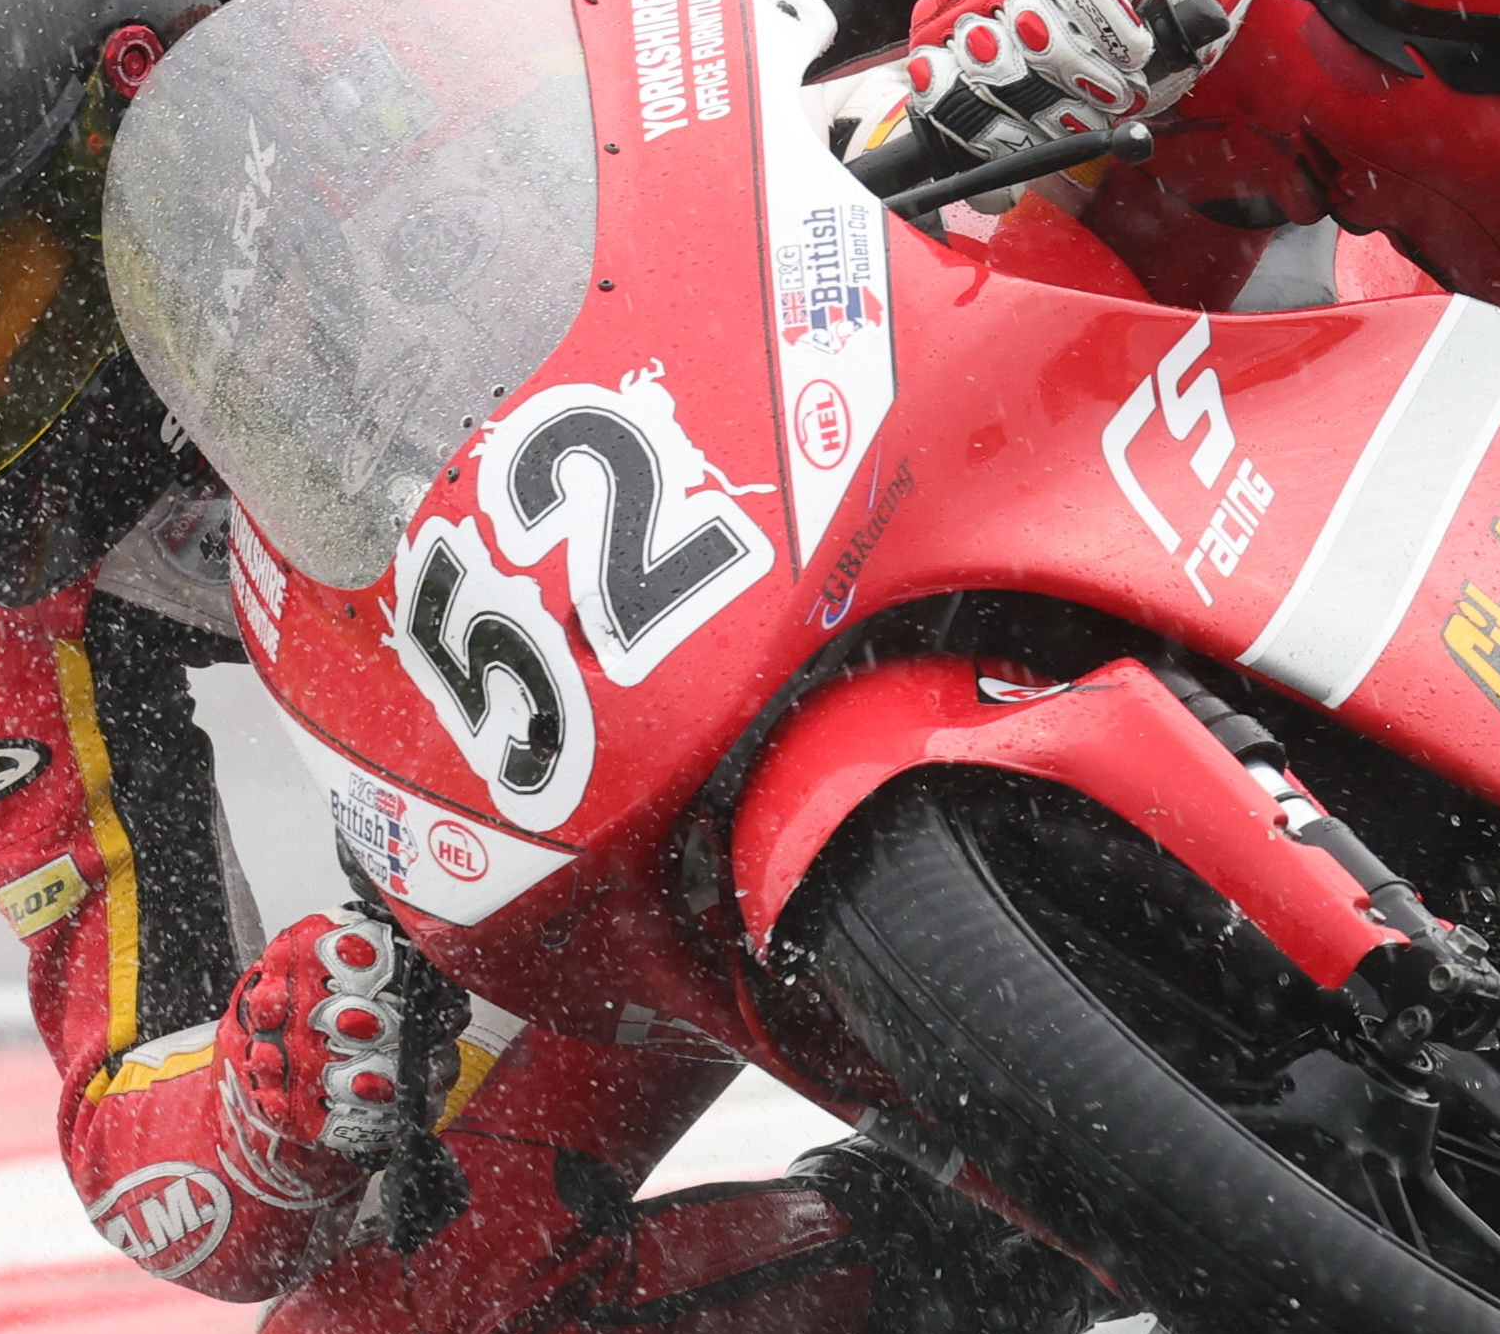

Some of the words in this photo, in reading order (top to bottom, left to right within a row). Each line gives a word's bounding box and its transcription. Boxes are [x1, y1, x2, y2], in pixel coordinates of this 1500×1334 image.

[693, 58, 732, 121] OFFICE
[848, 204, 869, 230] Cup
[803, 208, 843, 306] British
[850, 234, 871, 284] Talent
[816, 392, 841, 453] HEL
[408, 405, 750, 795] 52
[330, 788, 385, 851] British
[437, 839, 478, 874] HEL
